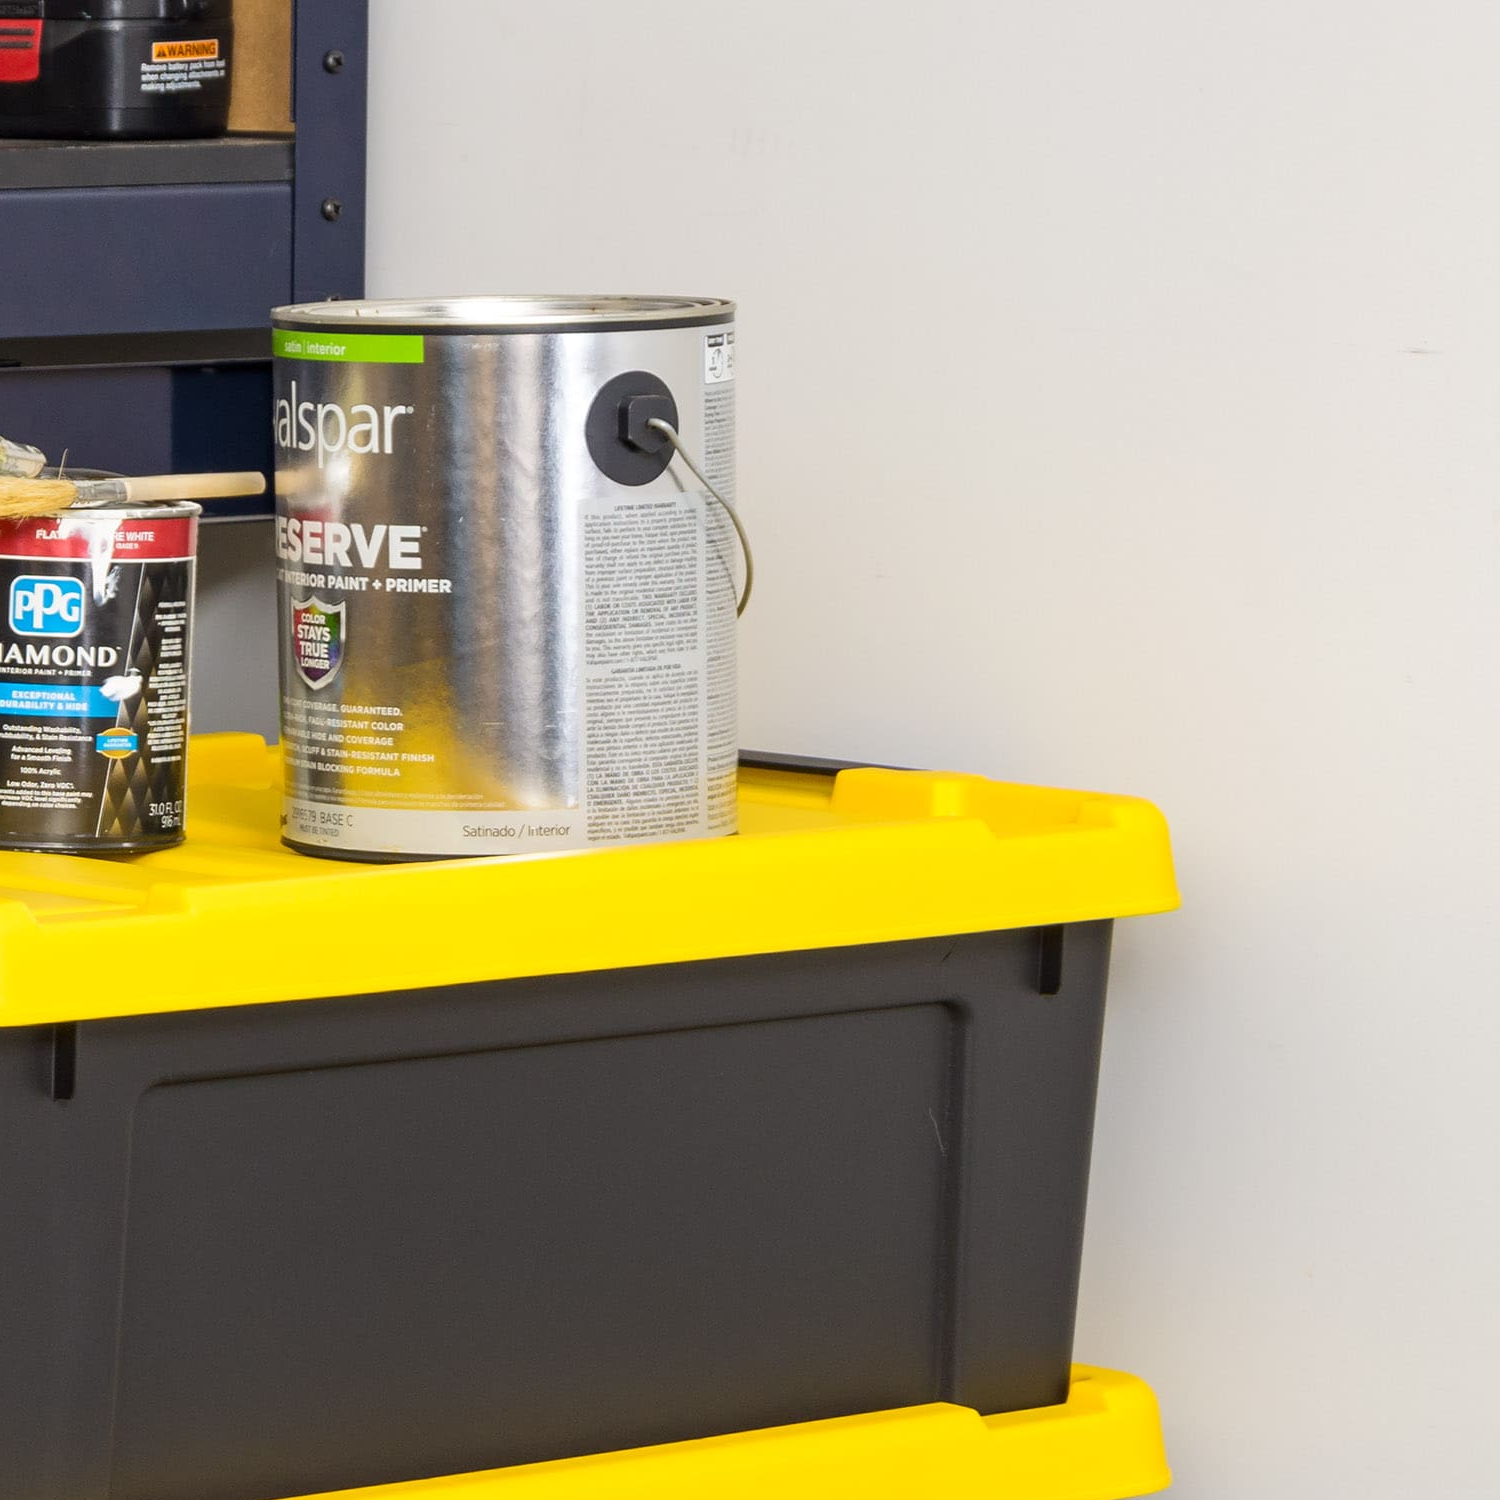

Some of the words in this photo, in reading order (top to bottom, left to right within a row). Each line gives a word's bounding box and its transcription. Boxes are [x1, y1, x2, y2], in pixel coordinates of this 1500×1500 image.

[167, 42, 216, 57] WARNING
[284, 341, 302, 353] satin
[307, 341, 346, 356] interior
[126, 530, 155, 542] WHITE
[275, 515, 423, 570] ESERVE
[285, 571, 325, 588] INTERIOR
[327, 575, 369, 591] PAINT
[372, 579, 382, 590] +
[385, 578, 452, 594] PRIMER
[15, 583, 81, 629] PPG
[301, 613, 326, 624] COLOR
[297, 625, 331, 641] STAYS
[300, 641, 329, 658] TRUE
[301, 657, 330, 670] LONGER
[34, 668, 56, 676] PAINT
[64, 669, 92, 677] PRIMER
[12, 691, 76, 701] EXCEPTIONAL
[0, 699, 54, 710] DURABILITY
[57, 702, 64, 710] &
[65, 702, 88, 711] HIDE
[340, 704, 403, 717] GUARANTEED.
[2, 724, 42, 734] Outstanding
[371, 721, 404, 731] COLOR
[42, 733, 58, 741] Stain
[59, 734, 93, 742] Resistance
[327, 733, 344, 743] AND
[345, 735, 394, 746] COVERAGE
[12, 745, 43, 753] Advanced
[326, 748, 399, 761] STAIN-RESISTANT
[401, 753, 435, 762] FINISH
[317, 762, 355, 774] BLOCKING
[356, 766, 401, 777] FORMULA
[320, 811, 344, 826] BASE
[346, 814, 354, 827] C
[462, 825, 516, 837] Satinado
[528, 824, 570, 837] Interior
